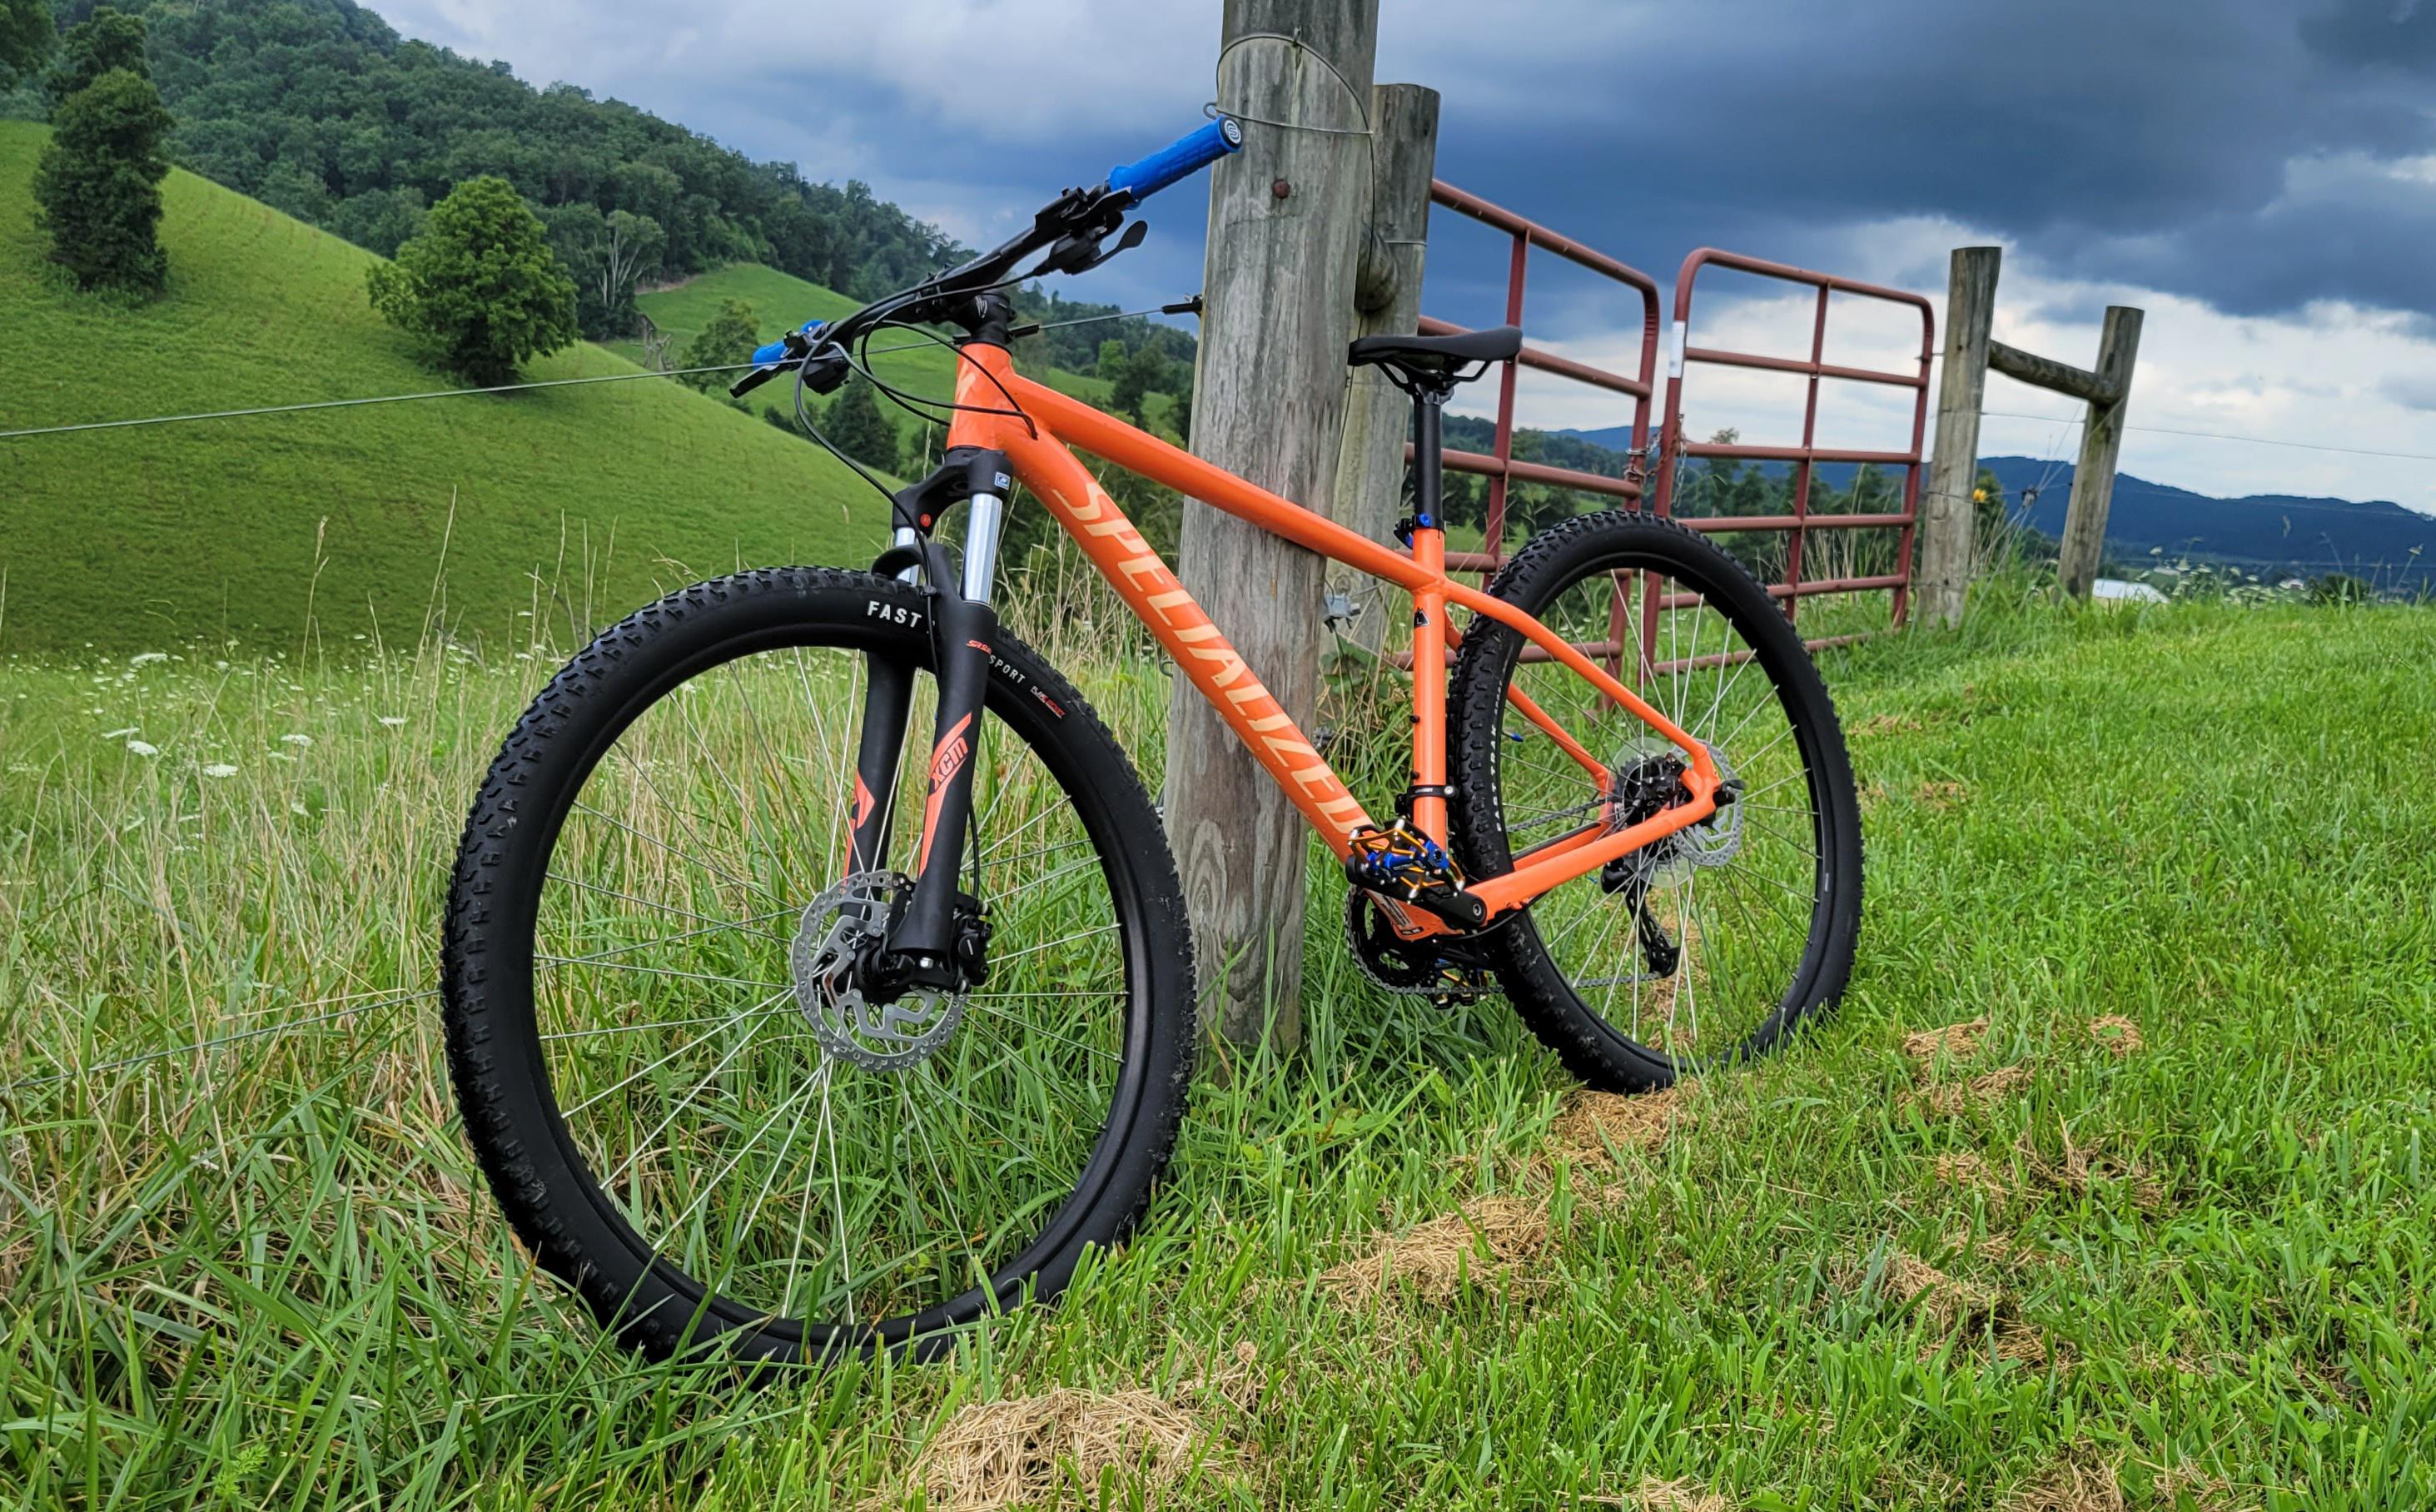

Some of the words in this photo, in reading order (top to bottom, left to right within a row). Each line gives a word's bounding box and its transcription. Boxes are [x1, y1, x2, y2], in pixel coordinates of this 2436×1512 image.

[867, 600, 922, 629] FAST
[1415, 617, 1424, 625] L
[989, 654, 1026, 684] SPORT
[1051, 481, 1375, 834] SPECIALIZED
[1491, 782, 1502, 832] FAST
